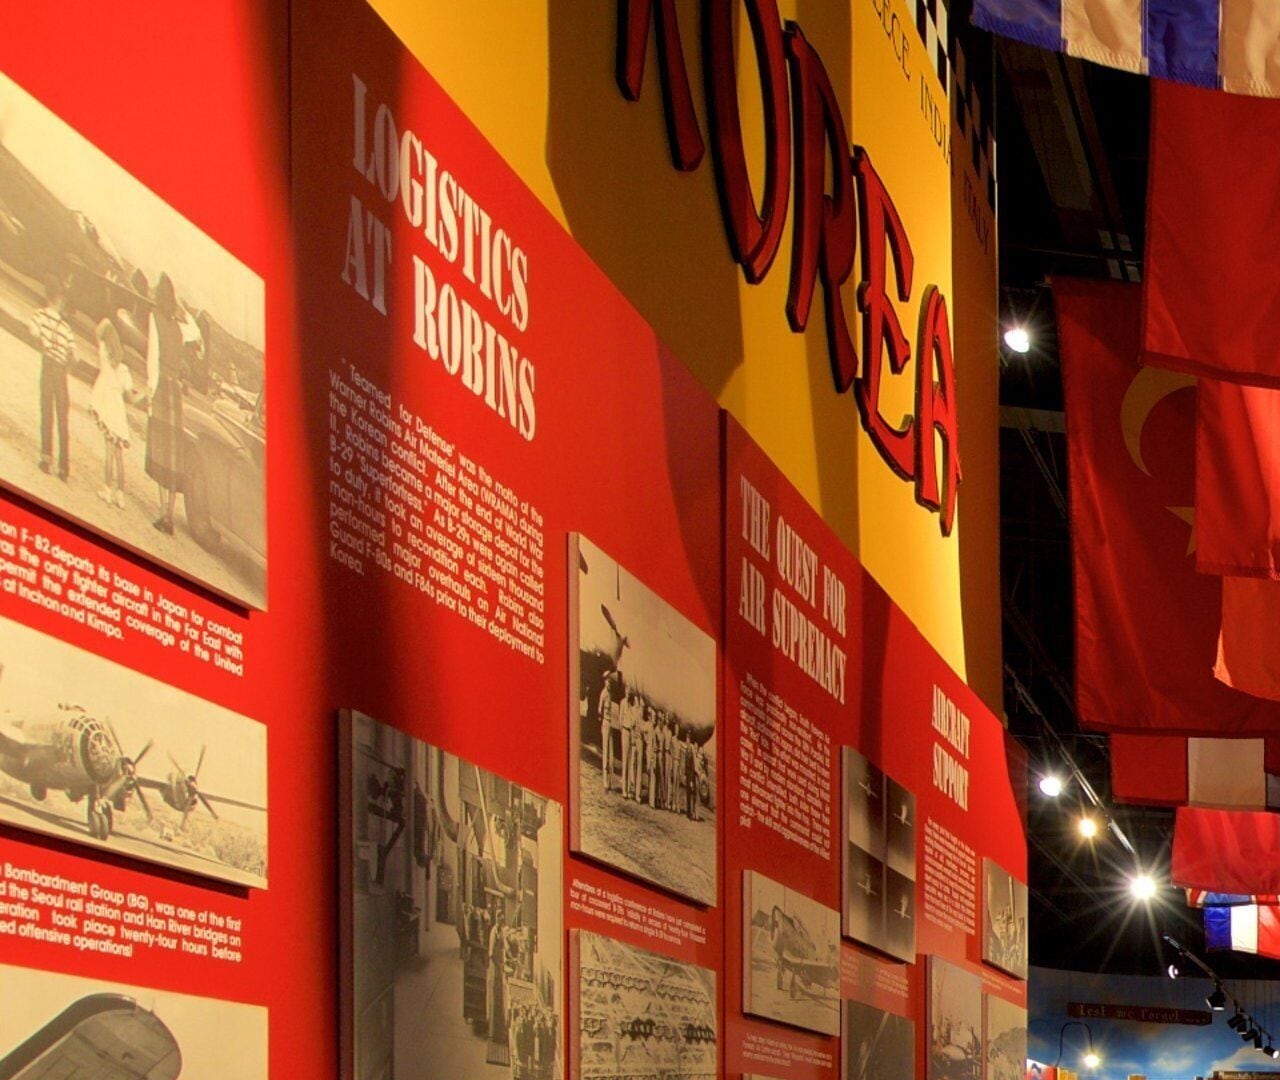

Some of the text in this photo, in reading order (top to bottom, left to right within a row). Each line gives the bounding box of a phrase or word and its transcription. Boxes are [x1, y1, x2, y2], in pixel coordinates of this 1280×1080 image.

[350, 74, 529, 332] LOGISTICS
[342, 194, 535, 441] AT ROBINS
[329, 370, 366, 409] Warner
[370, 401, 402, 435] Robins
[405, 427, 416, 446] Air
[459, 469, 479, 492] Area
[520, 515, 543, 542] during
[400, 406, 411, 424] for
[460, 456, 476, 473] was
[479, 468, 492, 486] the
[496, 484, 518, 505] motto
[521, 503, 528, 513] of
[531, 508, 543, 524] the
[4, 579, 16, 593] at
[62, 605, 85, 622] and
[20, 546, 243, 660] the only fighter aircraft in the Far East with
[52, 542, 94, 574] departs
[98, 565, 110, 582] its
[114, 573, 140, 596] base
[144, 588, 153, 602] in
[157, 595, 188, 618] Japan
[191, 612, 204, 626] for
[208, 623, 243, 645] combat
[740, 475, 846, 638] THE QUEST FOR
[43, 575, 62, 595] the
[68, 590, 121, 621] extended
[126, 616, 175, 646] coverage
[181, 639, 189, 652] of
[195, 644, 210, 661] the
[215, 653, 243, 676] United
[740, 557, 846, 705] AIR SUPREMACY
[932, 685, 971, 760] AIRCRAFT
[933, 749, 968, 811] SUPPORT
[5, 863, 87, 894] Bombardment
[91, 884, 124, 906] Group
[156, 903, 175, 915] was
[178, 908, 195, 919] one
[198, 911, 207, 922] of
[210, 913, 224, 926] the
[227, 917, 241, 930] first
[9, 883, 241, 945] the Seoul rail station and Han River bridges on
[19, 923, 70, 943] offensive
[52, 911, 241, 960] took place twenty-four hours before
